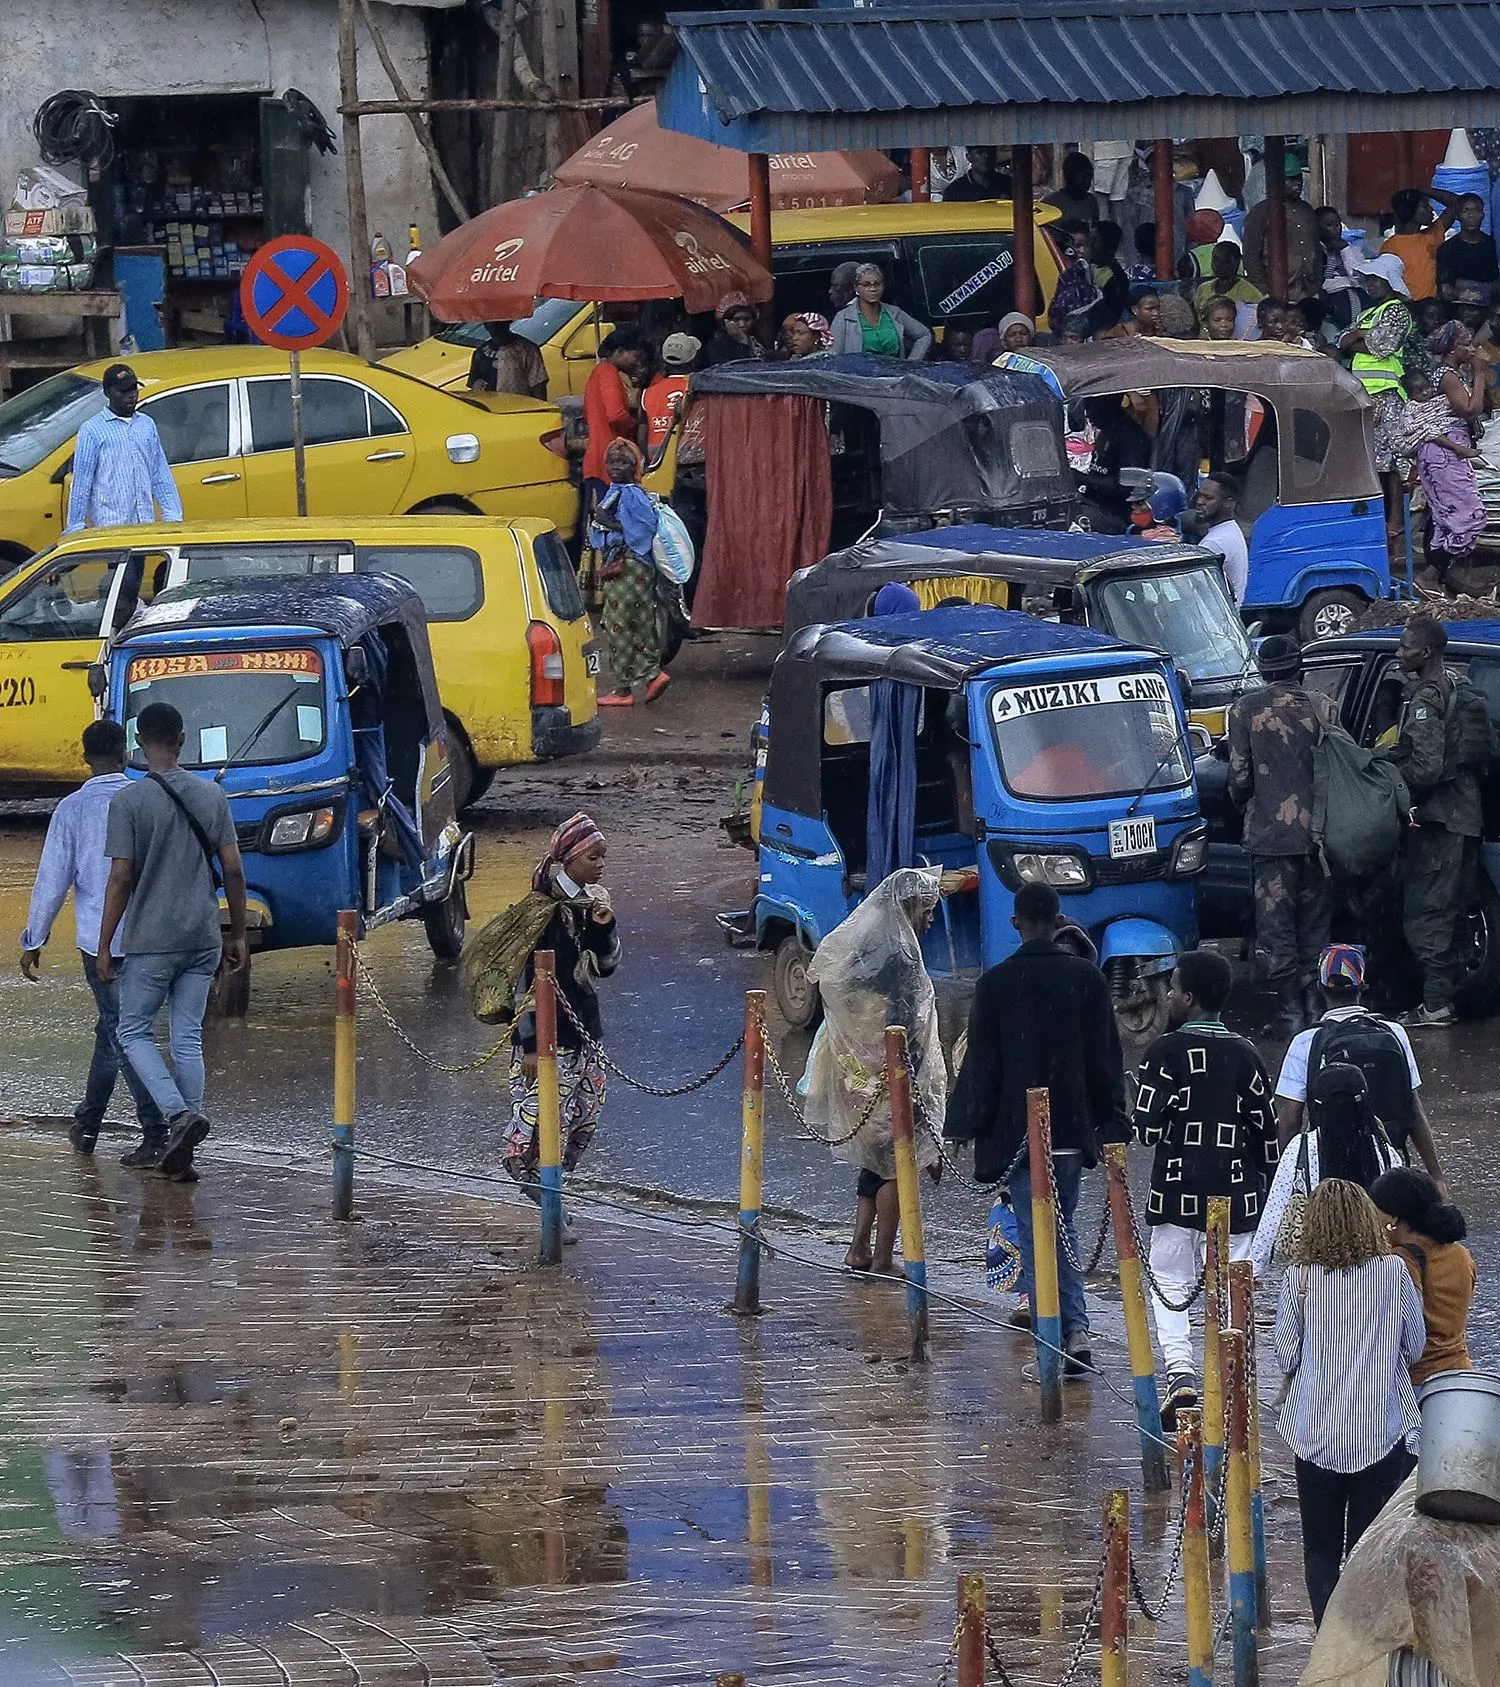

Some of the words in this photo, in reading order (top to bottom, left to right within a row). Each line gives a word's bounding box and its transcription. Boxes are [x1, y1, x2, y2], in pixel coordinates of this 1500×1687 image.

[609, 143, 639, 161] 4G
[769, 153, 817, 169] airtel
[27, 217, 42, 225] ATF
[470, 263, 520, 283] airtel
[684, 253, 730, 275] airtel
[131, 655, 208, 681] KOSA
[0, 677, 35, 707] 20
[1013, 682, 1100, 714] MUZIKI
